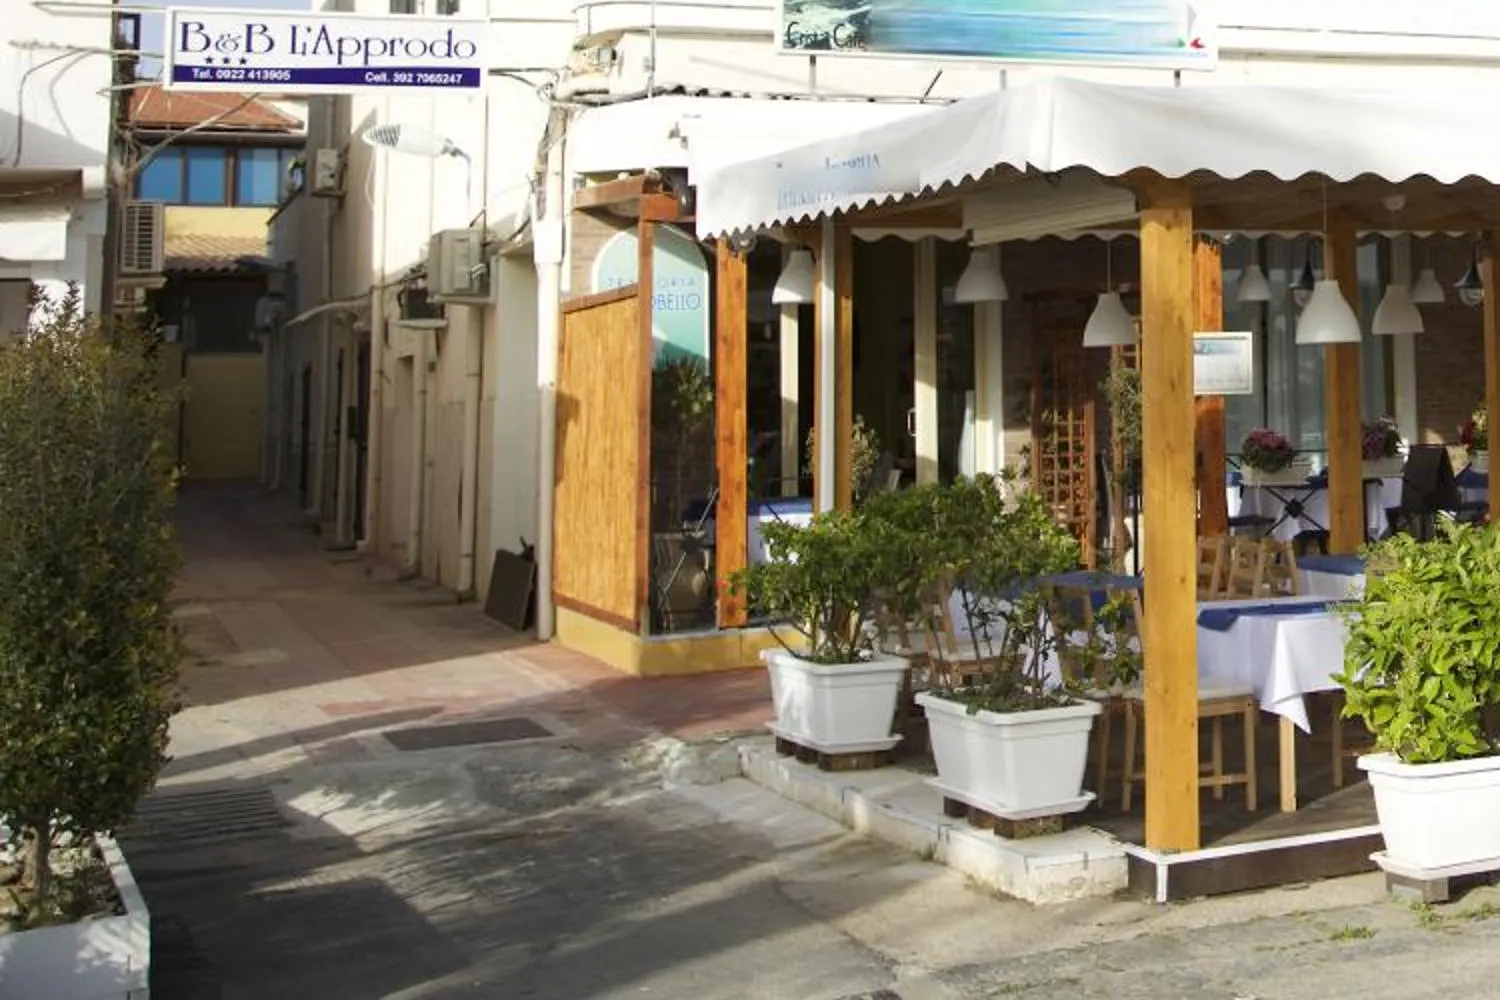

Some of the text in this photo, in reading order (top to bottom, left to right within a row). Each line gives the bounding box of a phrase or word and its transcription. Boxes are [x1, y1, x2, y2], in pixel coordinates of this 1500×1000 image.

[179, 21, 477, 66] B&B L'Approdo
[192, 67, 214, 79] Tel.
